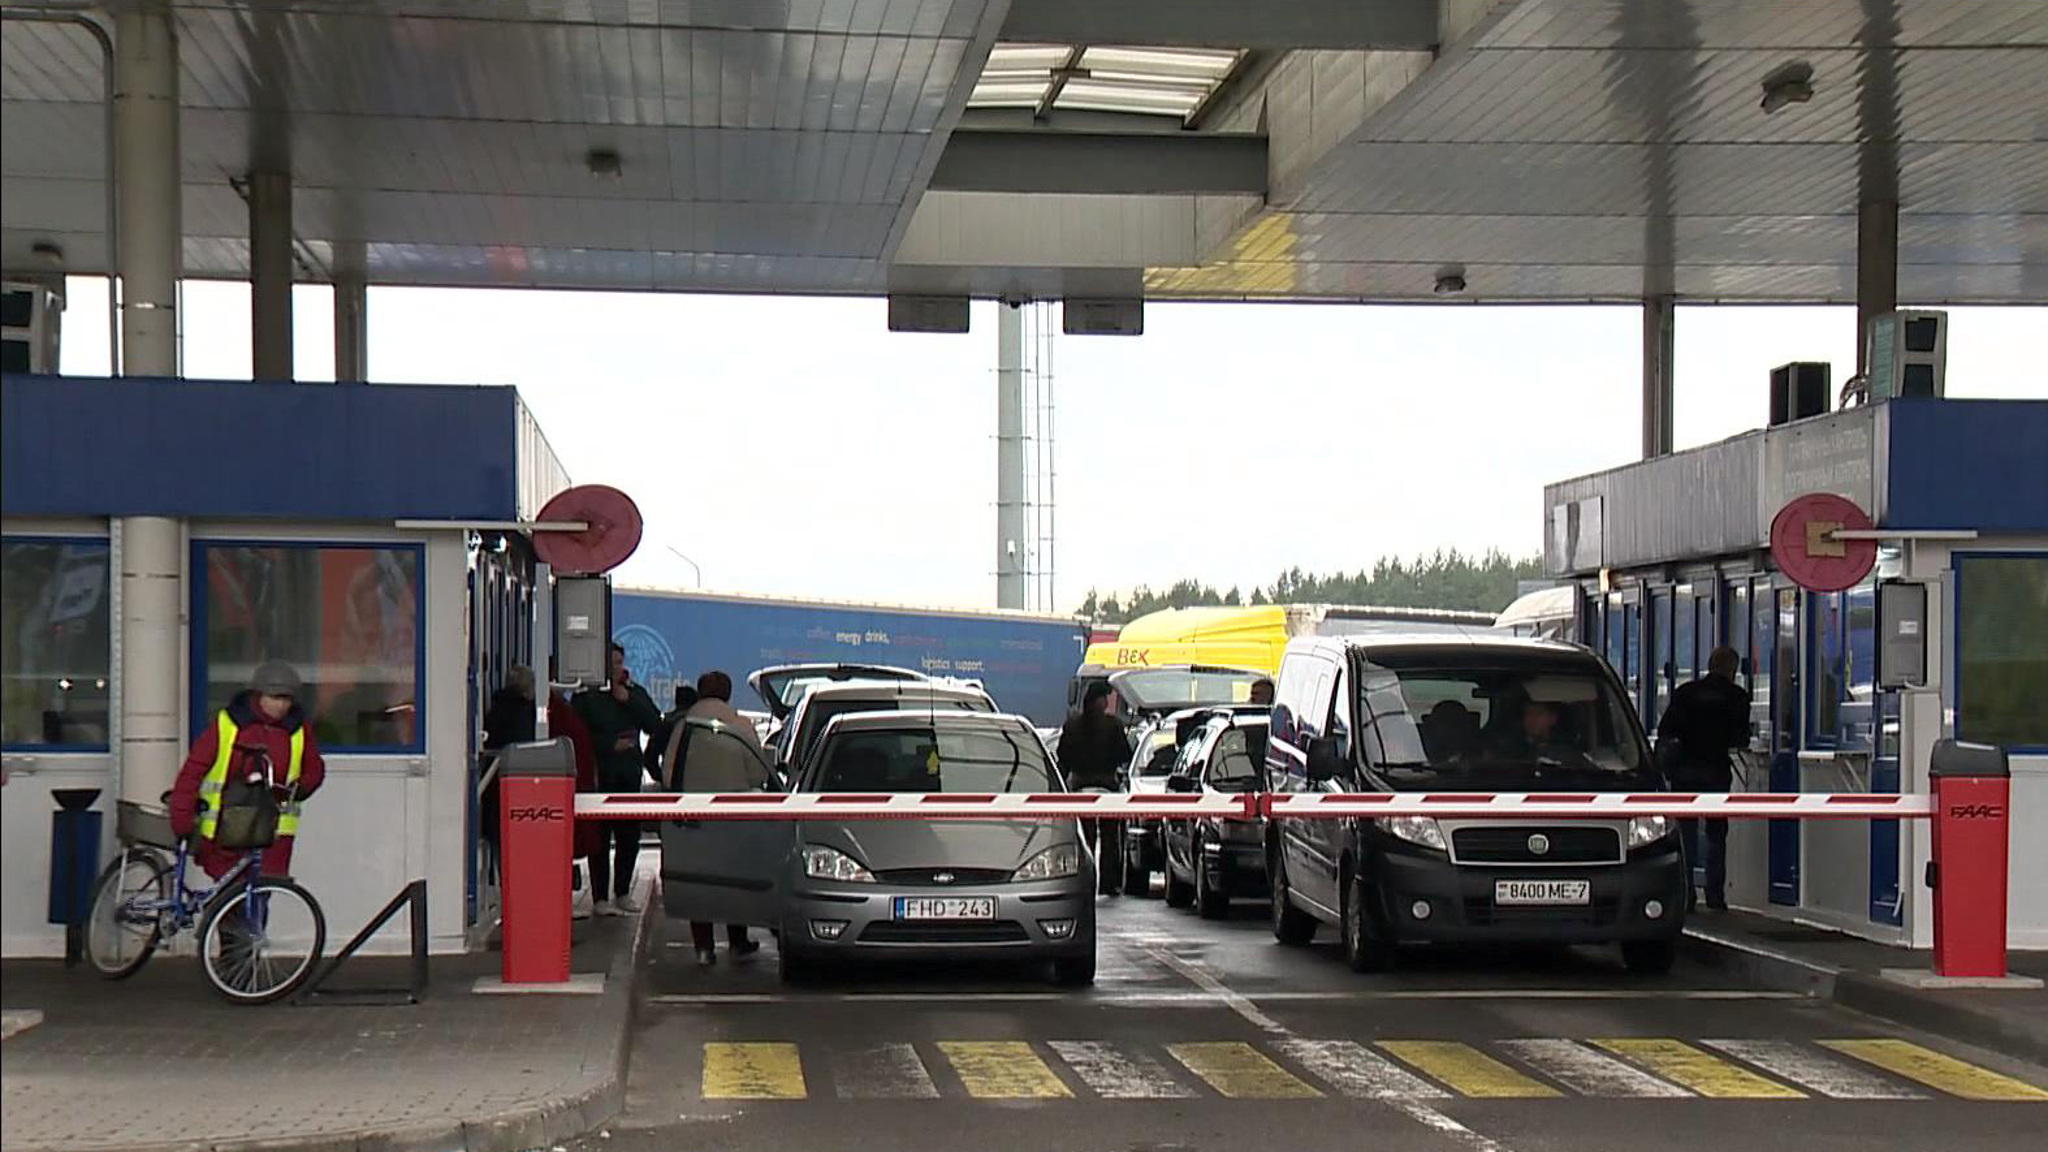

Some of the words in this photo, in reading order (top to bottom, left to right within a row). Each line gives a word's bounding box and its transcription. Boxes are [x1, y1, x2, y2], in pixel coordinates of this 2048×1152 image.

[836, 632, 861, 646] energy
[510, 808, 563, 821] FAAC
[1951, 805, 2002, 818] FAAC
[1510, 883, 1545, 898] 8400
[1549, 883, 1587, 898] ME-7
[906, 899, 946, 917] FHD
[958, 899, 991, 917] 243
